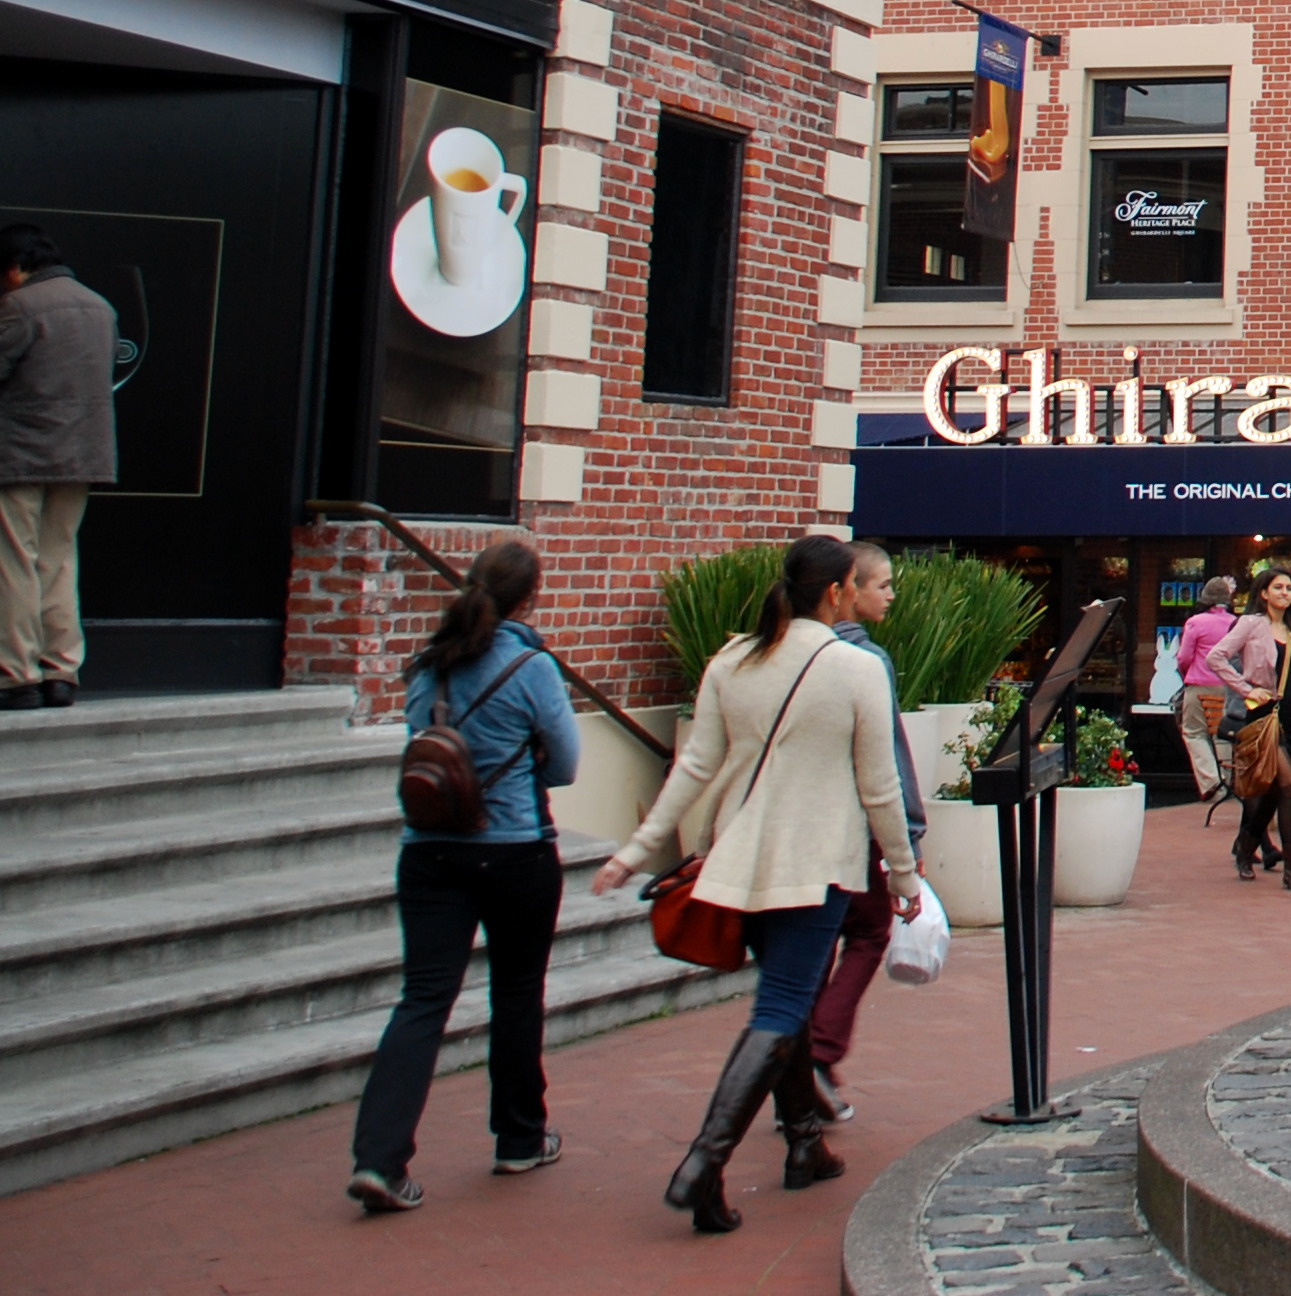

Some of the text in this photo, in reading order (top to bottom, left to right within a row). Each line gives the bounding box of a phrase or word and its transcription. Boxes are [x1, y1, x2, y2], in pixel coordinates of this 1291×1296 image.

[1115, 190, 1208, 221] Fairmont
[1126, 484, 1167, 500] THE
[1173, 482, 1269, 500] ORIGINAL
